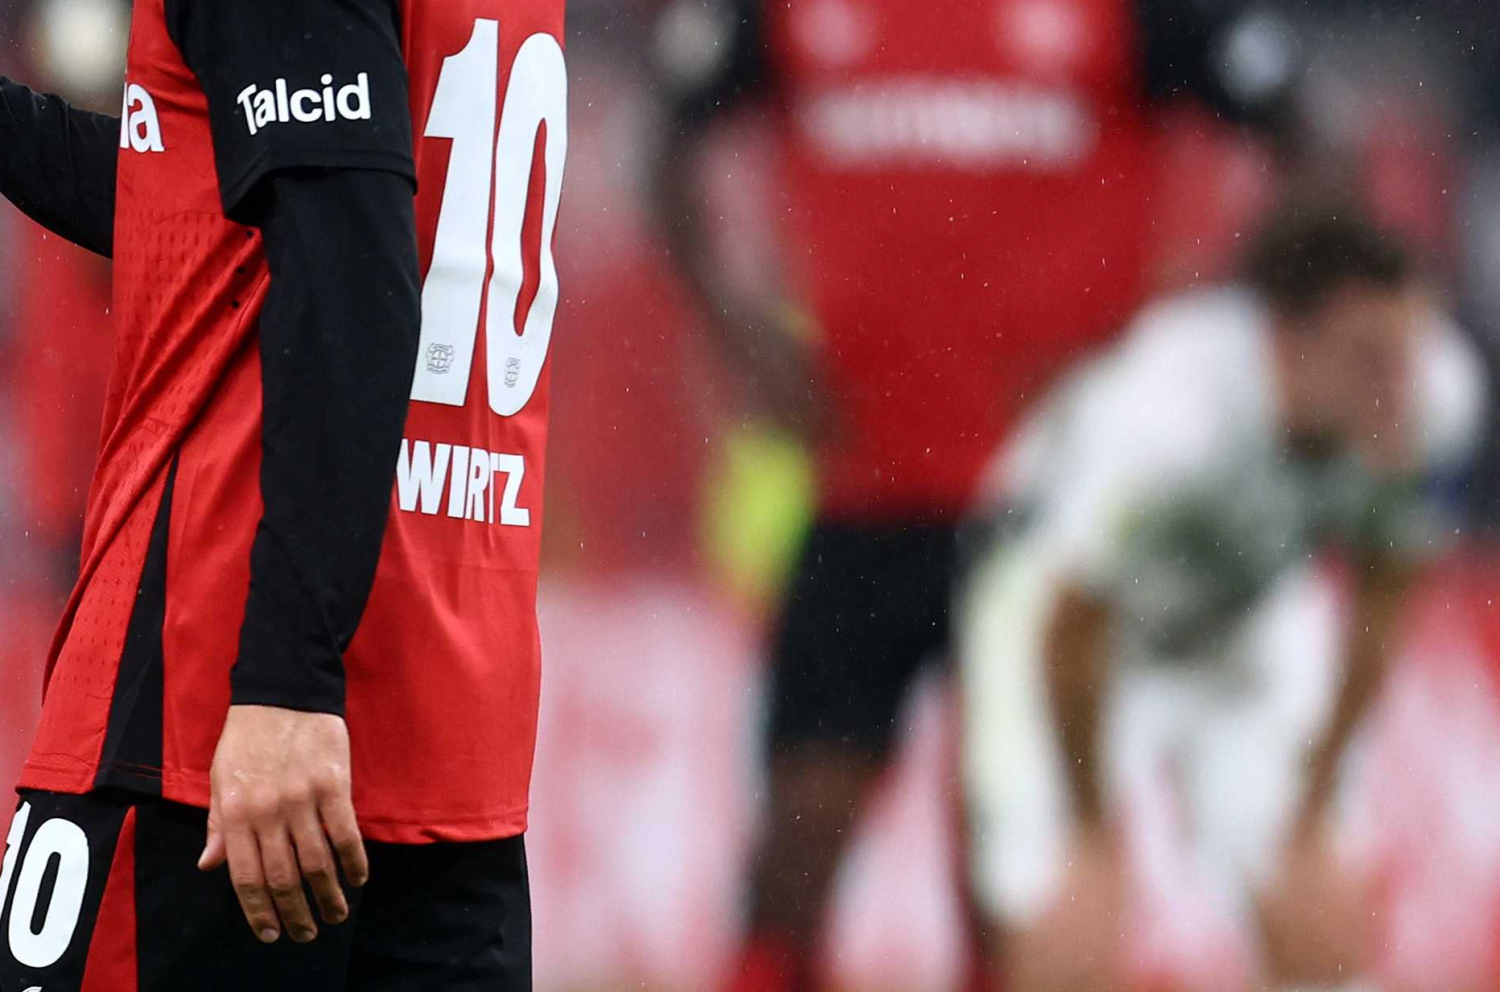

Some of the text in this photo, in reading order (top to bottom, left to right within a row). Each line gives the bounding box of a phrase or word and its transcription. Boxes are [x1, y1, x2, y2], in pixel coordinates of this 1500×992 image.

[237, 72, 371, 135] Talcid
[410, 18, 569, 416] 10
[396, 438, 530, 526] WIRTZ
